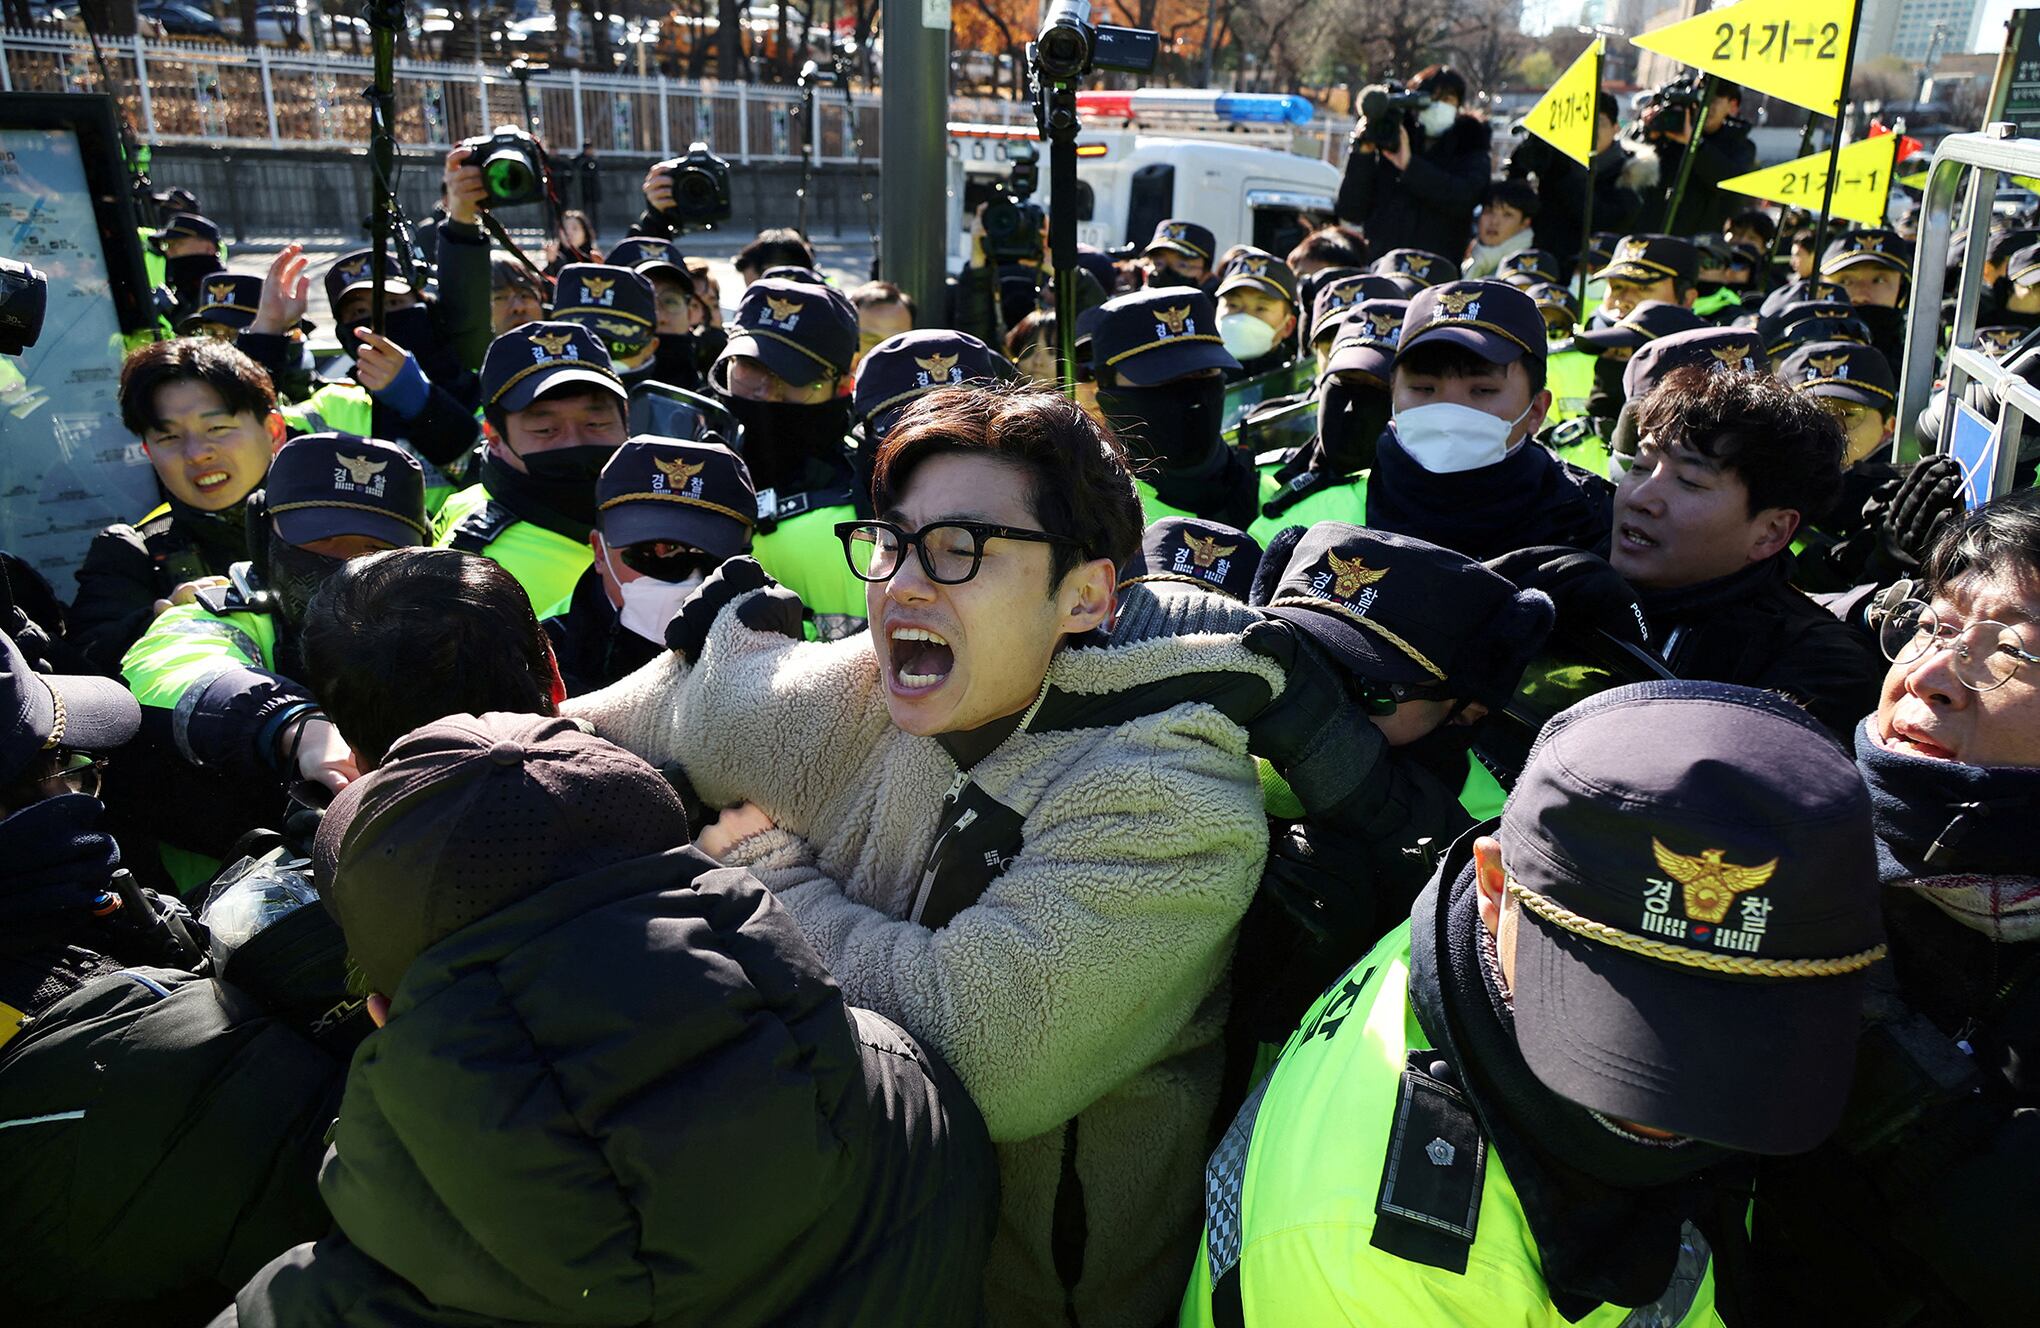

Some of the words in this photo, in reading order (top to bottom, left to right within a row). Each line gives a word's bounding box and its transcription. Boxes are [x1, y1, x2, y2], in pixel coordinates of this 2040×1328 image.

[1711, 20, 1840, 63] 21기-2
[1549, 91, 1591, 130] 21기-3
[1780, 169, 1878, 194] 21기-1
[1630, 602, 1648, 641] POLICE
